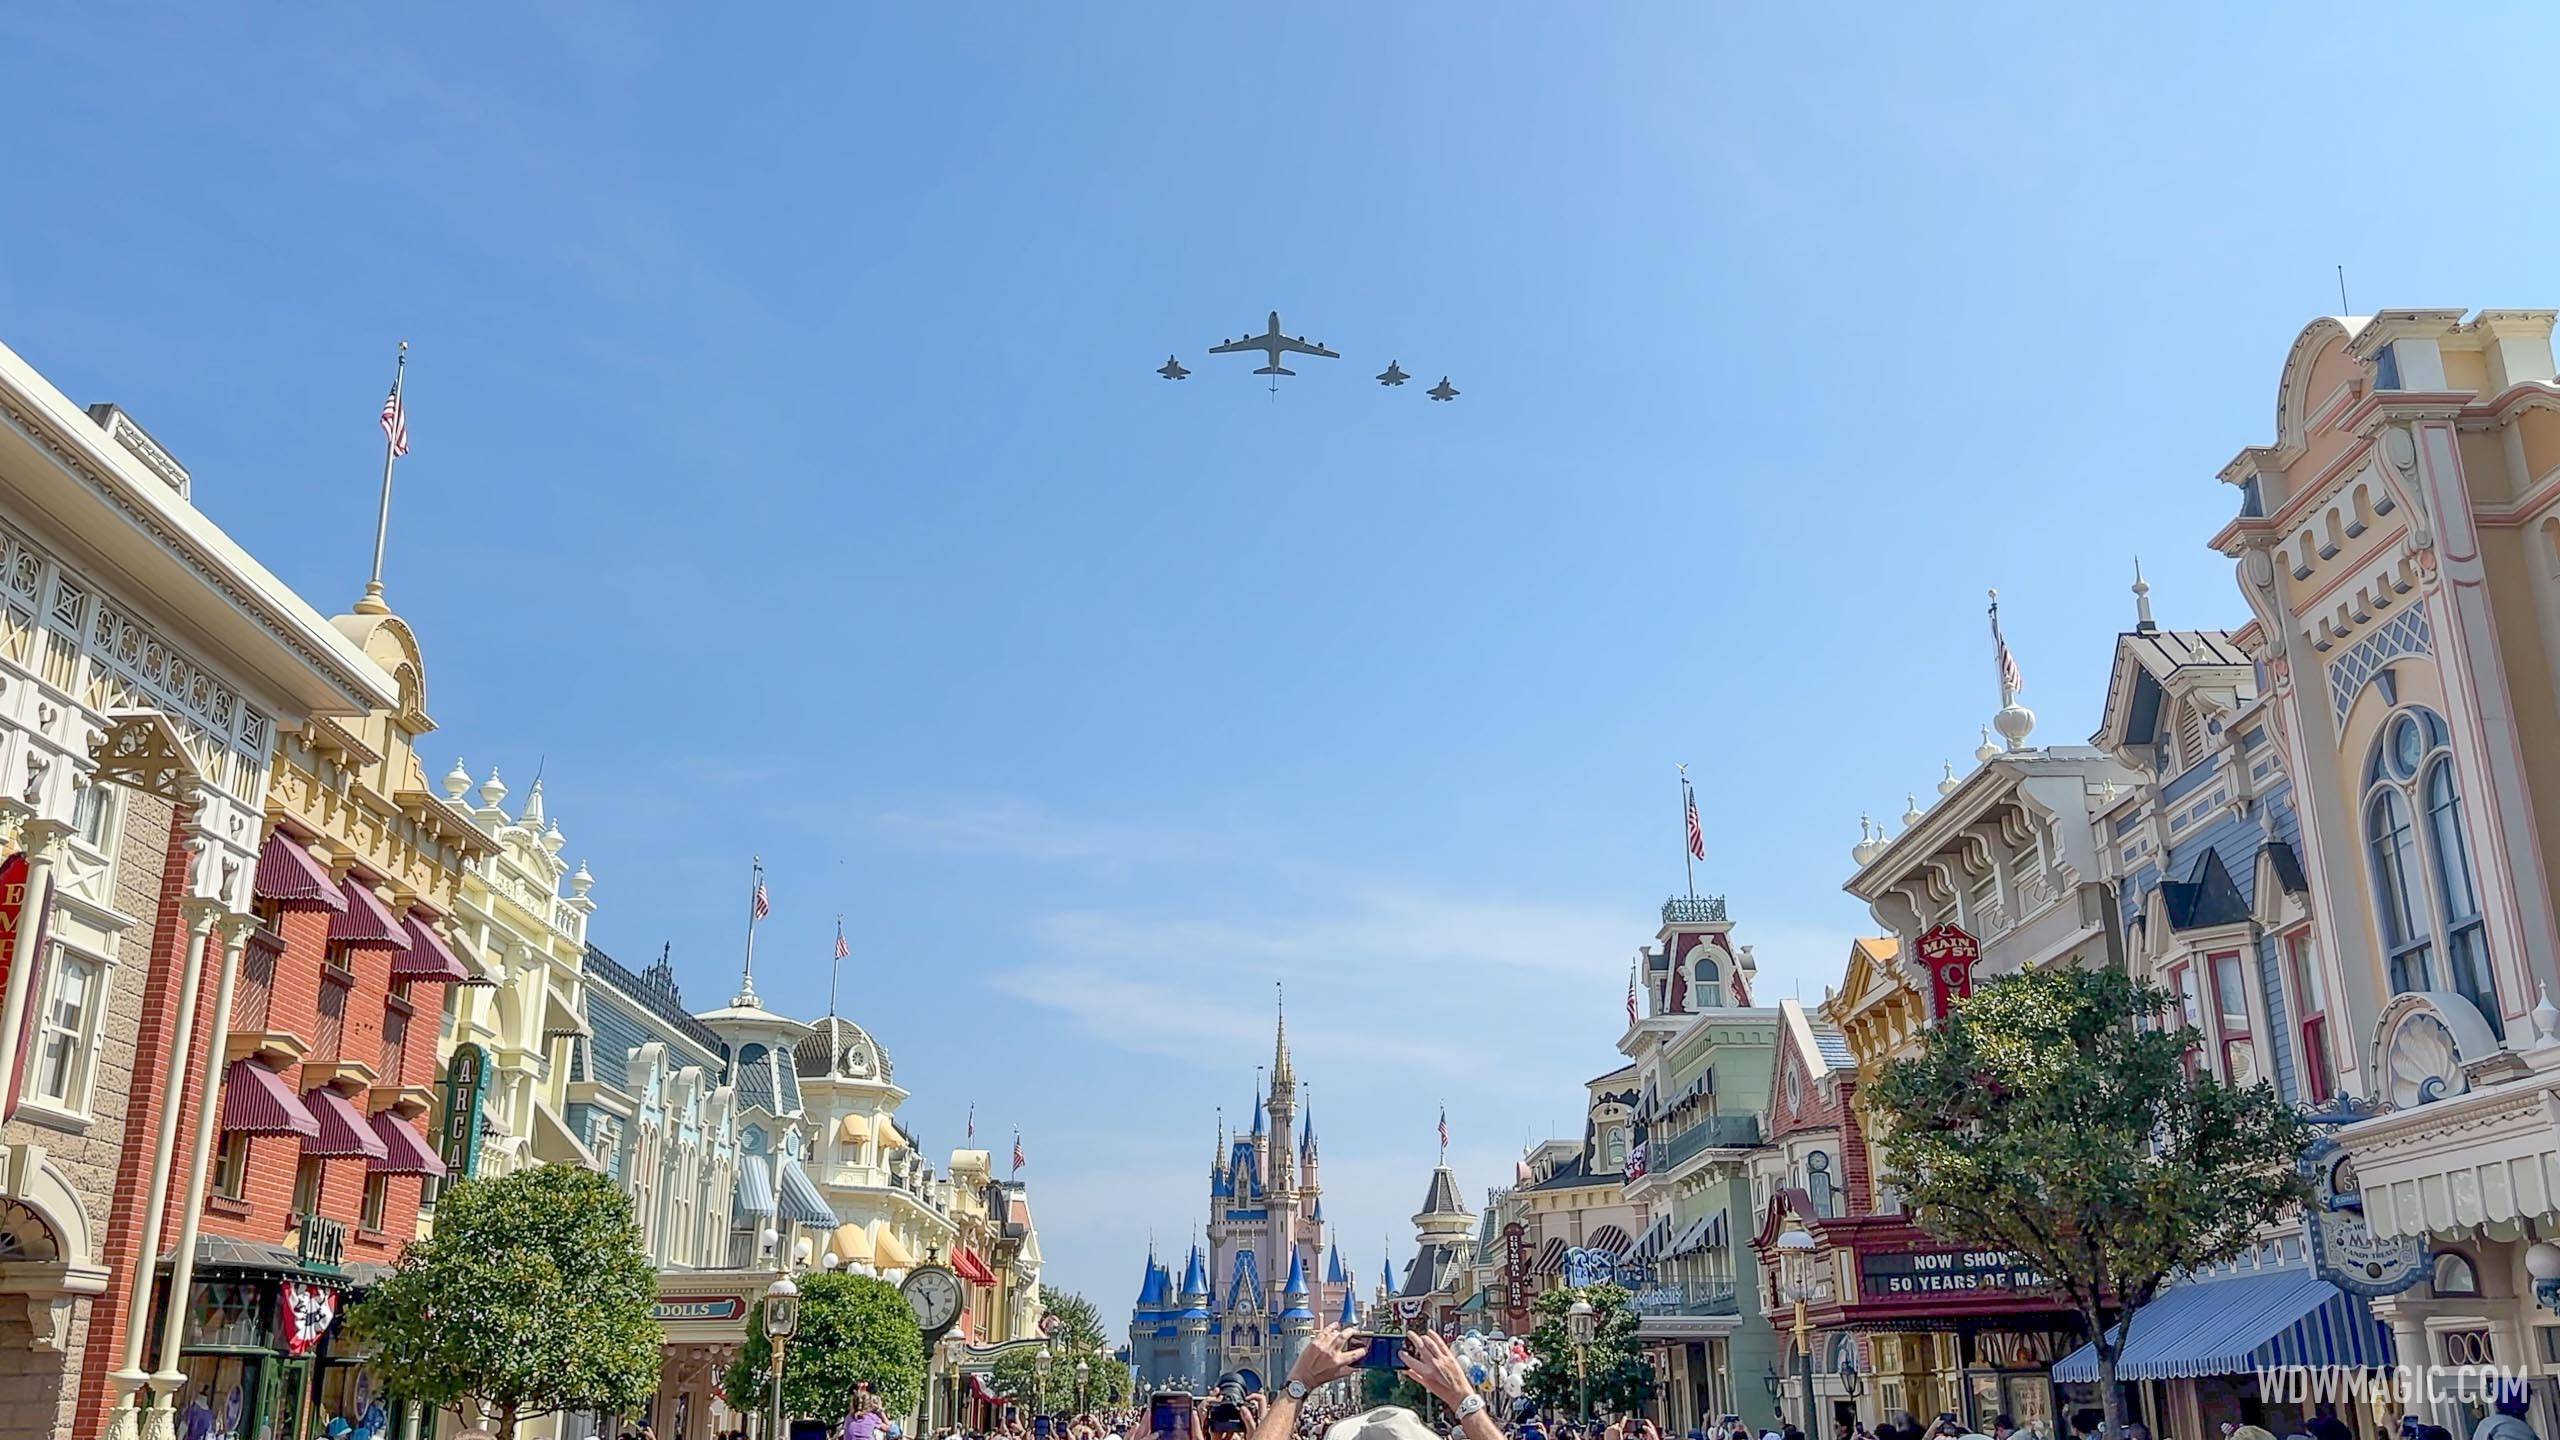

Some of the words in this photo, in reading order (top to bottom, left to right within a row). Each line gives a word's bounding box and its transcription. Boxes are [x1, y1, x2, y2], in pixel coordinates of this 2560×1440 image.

[1922, 937, 1970, 956] MAIN
[306, 1217, 347, 1264] GIFTS
[1510, 1235, 1520, 1277] CRYSTAL
[1914, 1254, 1952, 1270] NOW
[1890, 1277, 1912, 1291] 50
[1919, 1274, 1977, 1290] YEARS
[1983, 1273, 2006, 1287] OF
[660, 1304, 710, 1317] DOLLS
